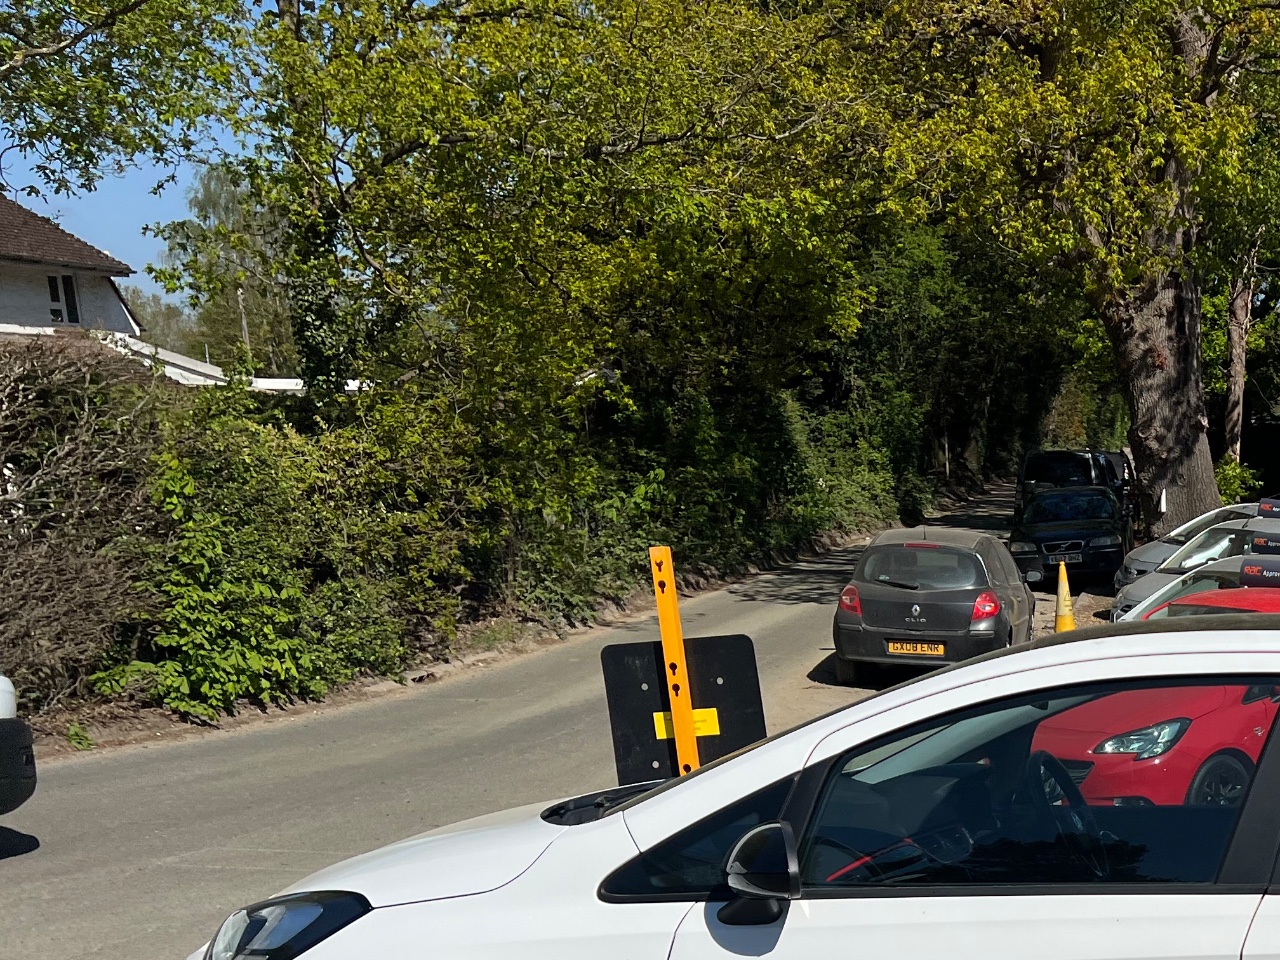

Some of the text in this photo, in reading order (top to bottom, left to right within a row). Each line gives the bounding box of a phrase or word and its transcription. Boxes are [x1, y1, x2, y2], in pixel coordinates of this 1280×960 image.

[1244, 566, 1262, 575] RAC
[892, 642, 940, 653] GX08 ENR
